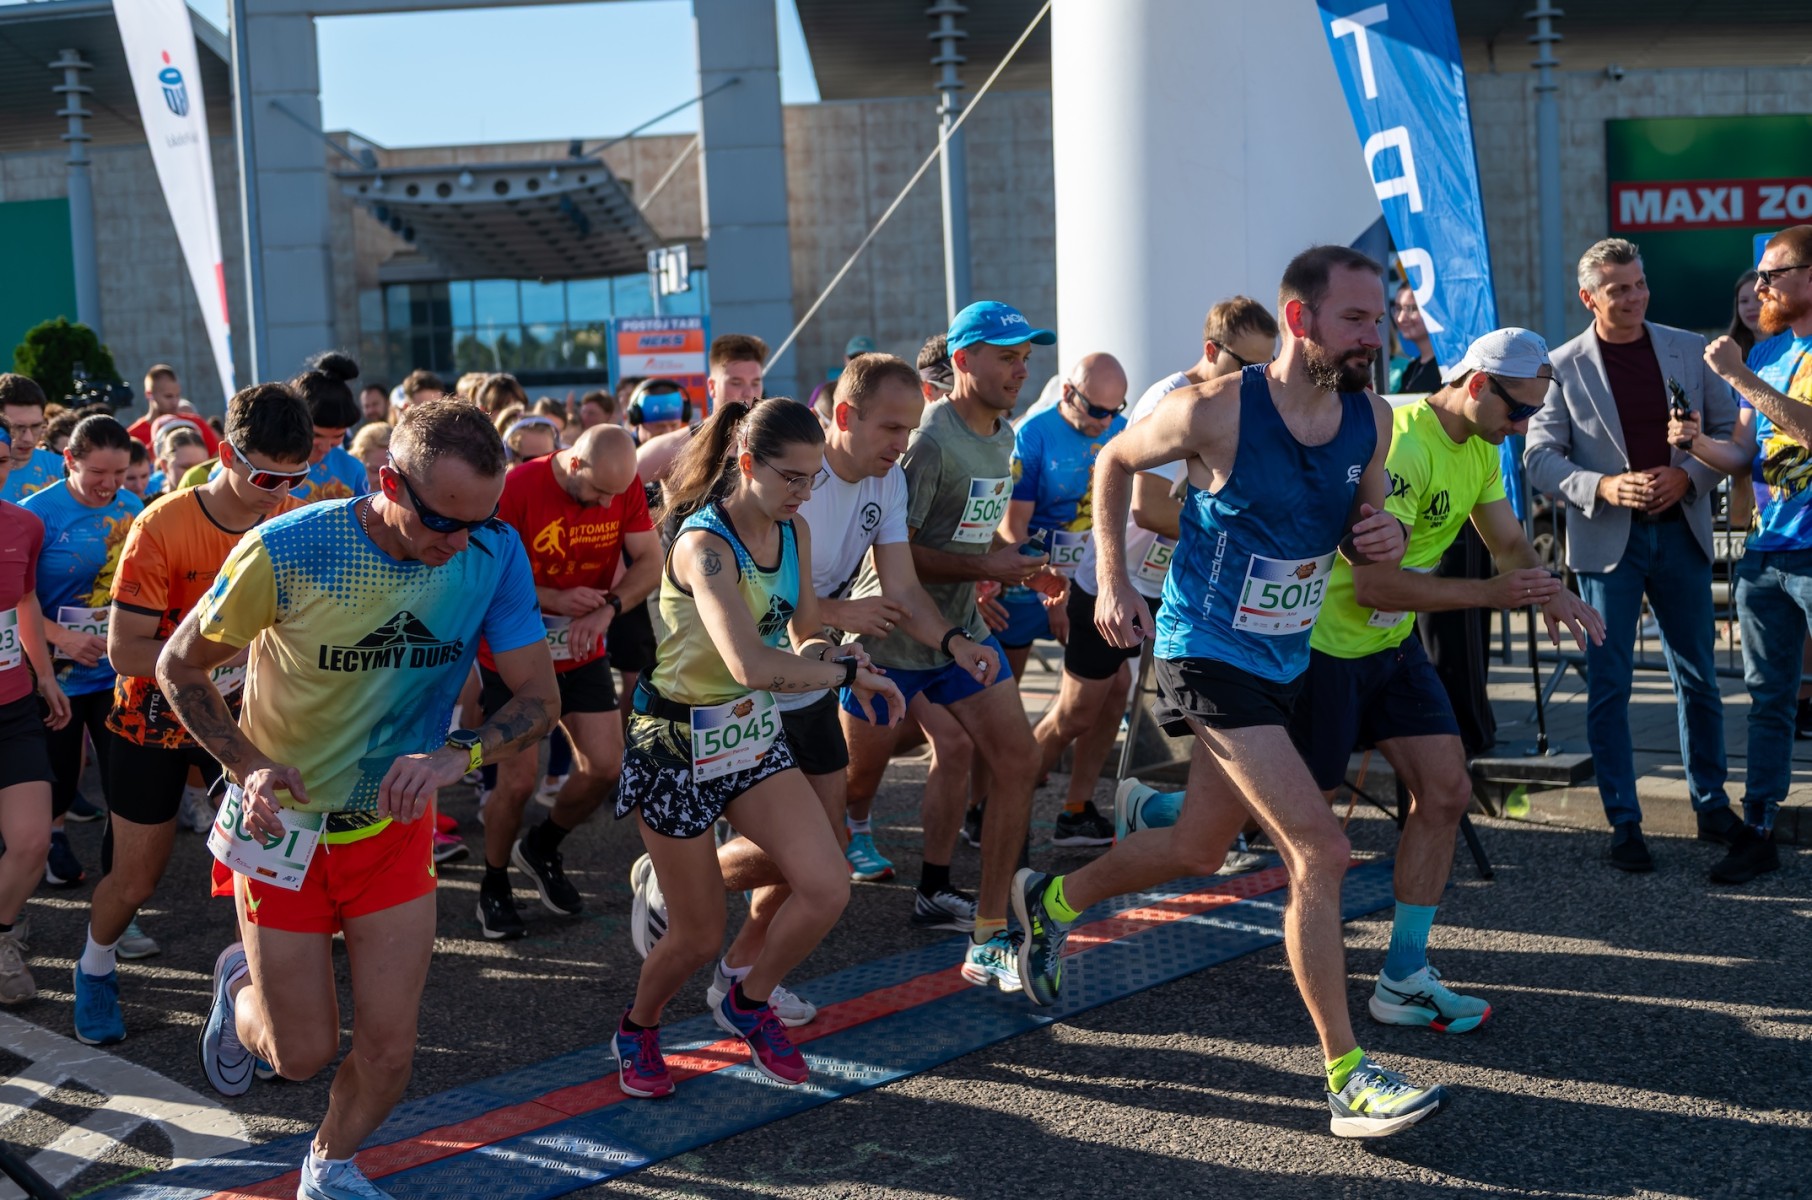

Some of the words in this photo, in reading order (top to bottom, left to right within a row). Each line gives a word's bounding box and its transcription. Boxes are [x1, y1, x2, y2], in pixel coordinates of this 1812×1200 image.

[1619, 186, 1743, 225] MAXI
[1758, 184, 1812, 220] ZO
[671, 318, 701, 330] TAXI
[638, 333, 685, 348] NEKS
[971, 496, 1008, 522] 5067
[1422, 489, 1450, 515] XIX
[570, 520, 619, 537] BYTOMSKI
[1259, 578, 1324, 610] 5013
[318, 644, 406, 673] LECYMY
[704, 710, 775, 756] 5045
